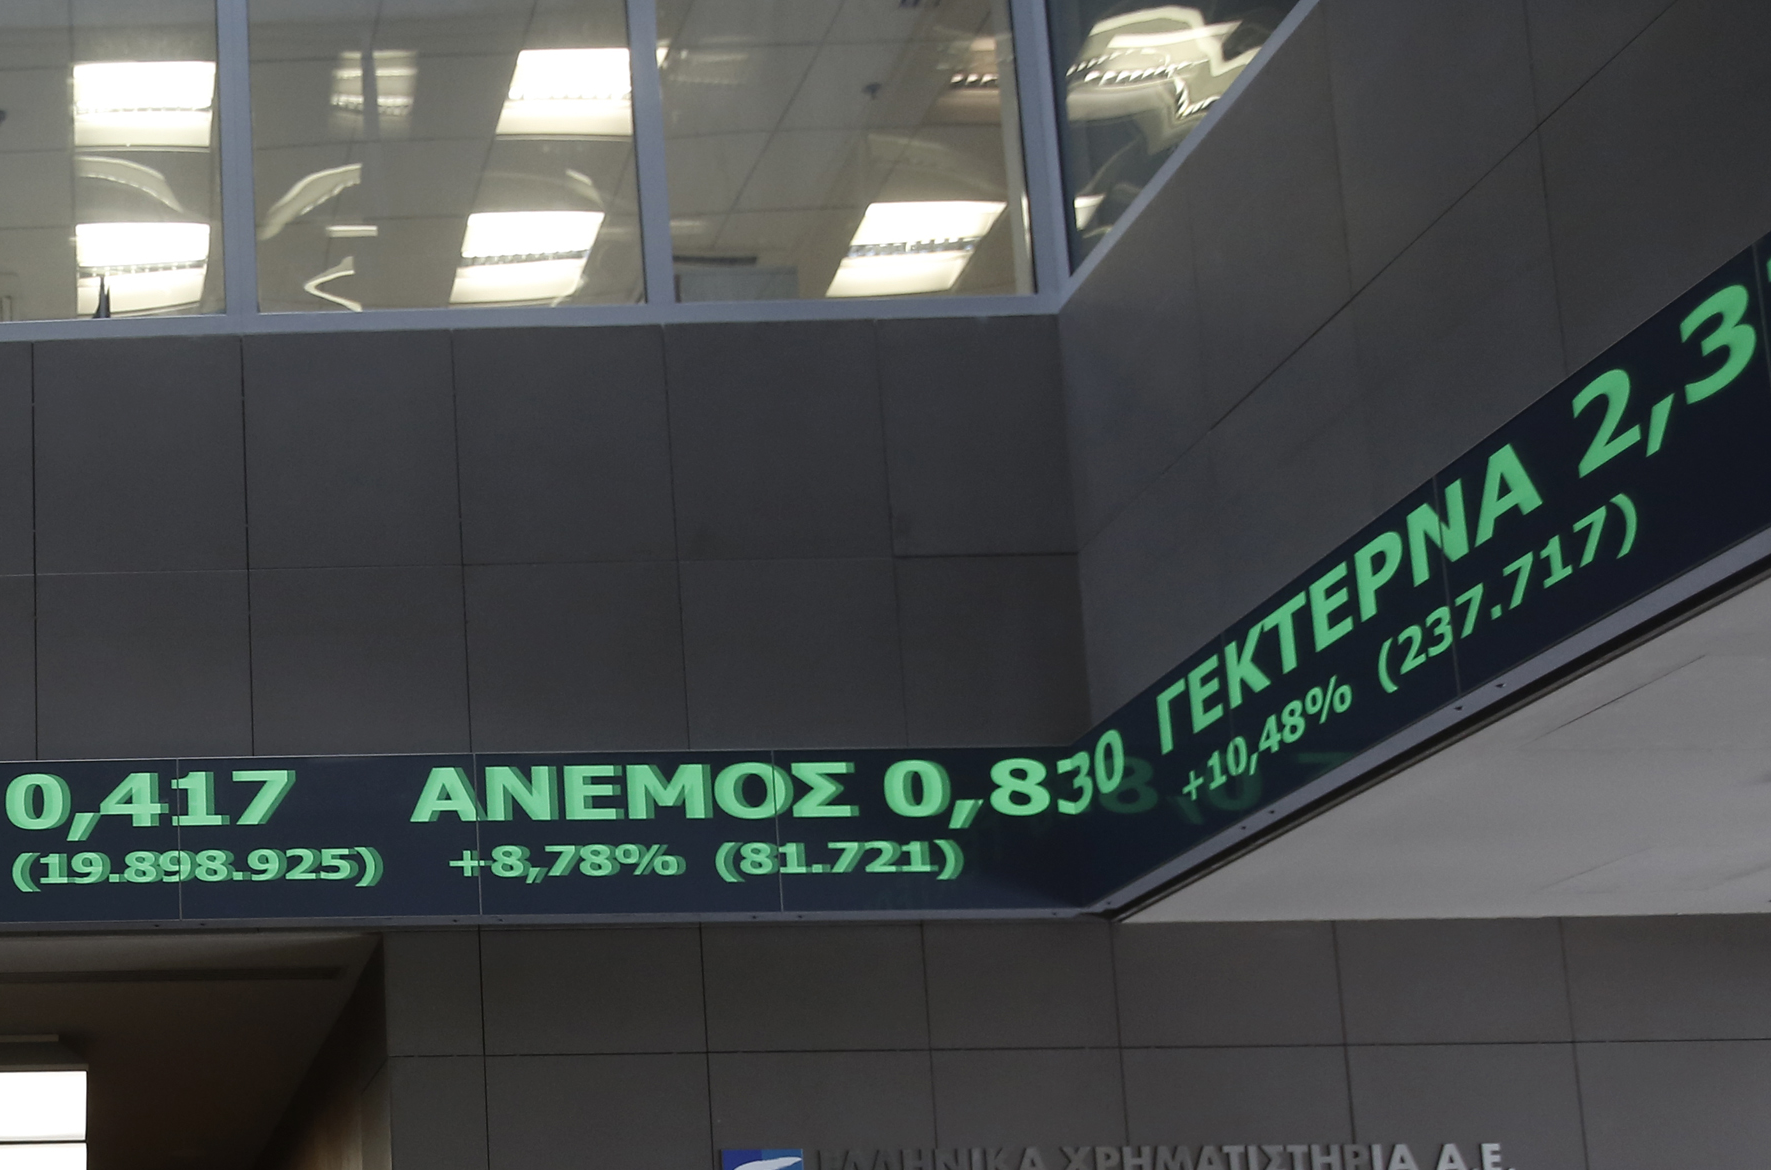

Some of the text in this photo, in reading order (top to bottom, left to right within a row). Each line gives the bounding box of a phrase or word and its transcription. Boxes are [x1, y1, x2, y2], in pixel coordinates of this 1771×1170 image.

[1156, 257, 1771, 755] ΓΕΚΤΕΡΝΑ 2,3
[1182, 675, 1353, 801] +10,48%
[1377, 493, 1638, 694] (237.717)
[5, 770, 296, 842] 0,417
[410, 762, 859, 823] ΑΝΕΜΟΣ
[11, 846, 384, 893] (19.898.925)
[449, 839, 963, 883] +8,78% (81.721)
